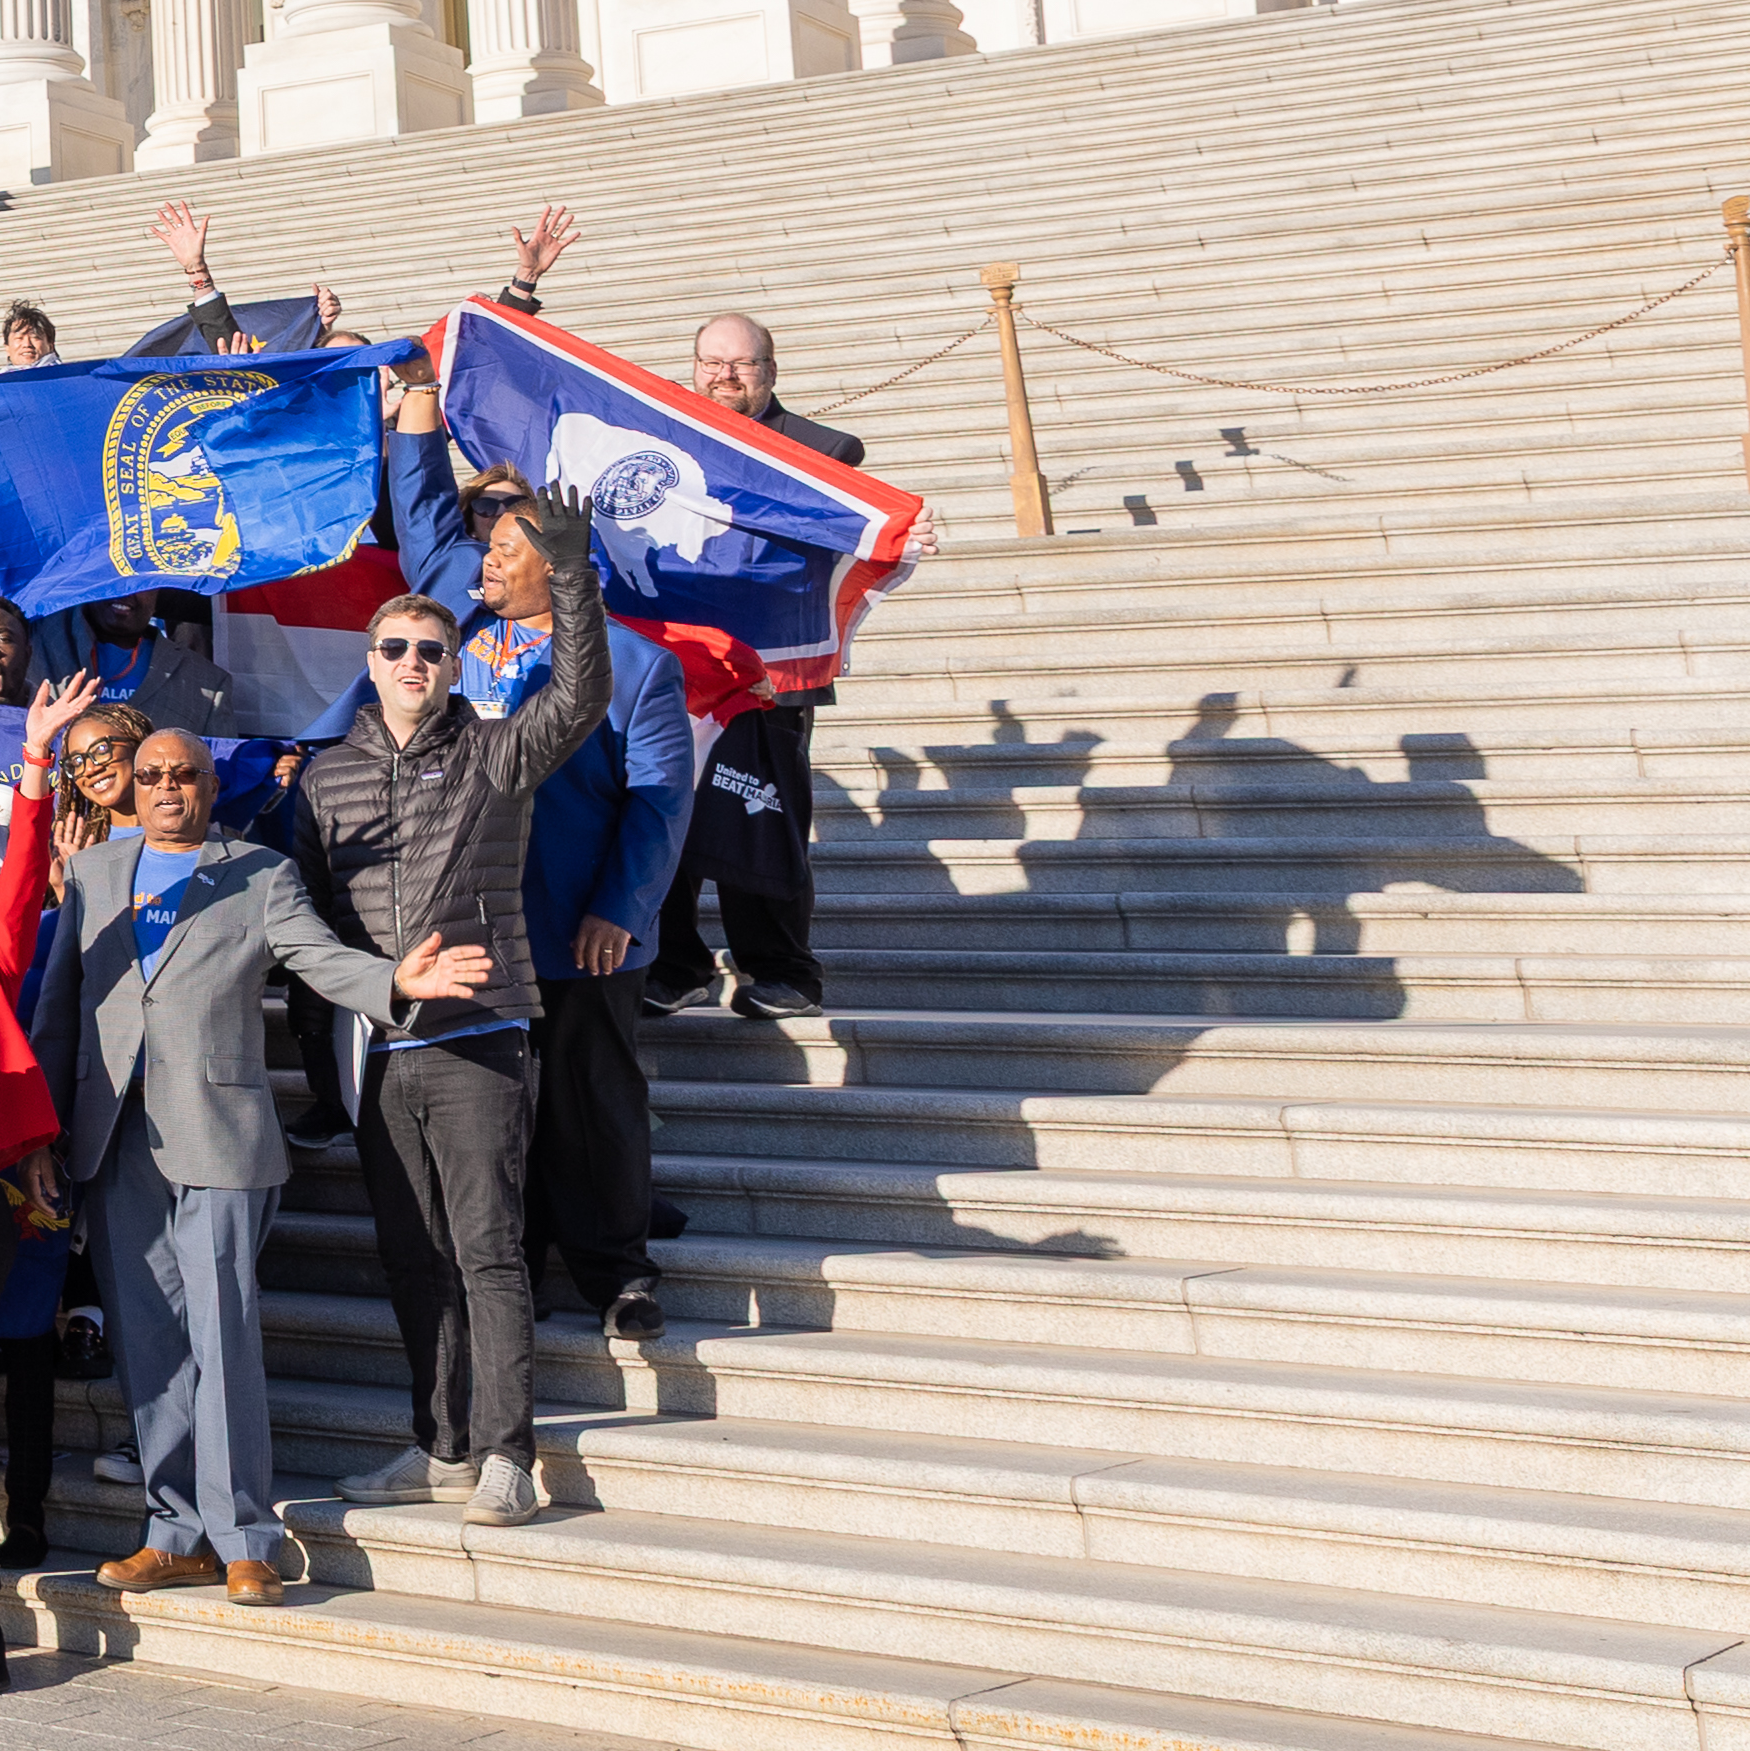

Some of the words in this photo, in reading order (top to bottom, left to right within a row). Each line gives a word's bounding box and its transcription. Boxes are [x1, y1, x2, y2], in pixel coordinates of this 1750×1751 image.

[120, 441, 137, 495] SEAL
[131, 404, 151, 428] OF
[154, 378, 193, 400] THE
[711, 773, 745, 796] BEAT
[715, 762, 749, 782] United
[748, 775, 760, 786] to
